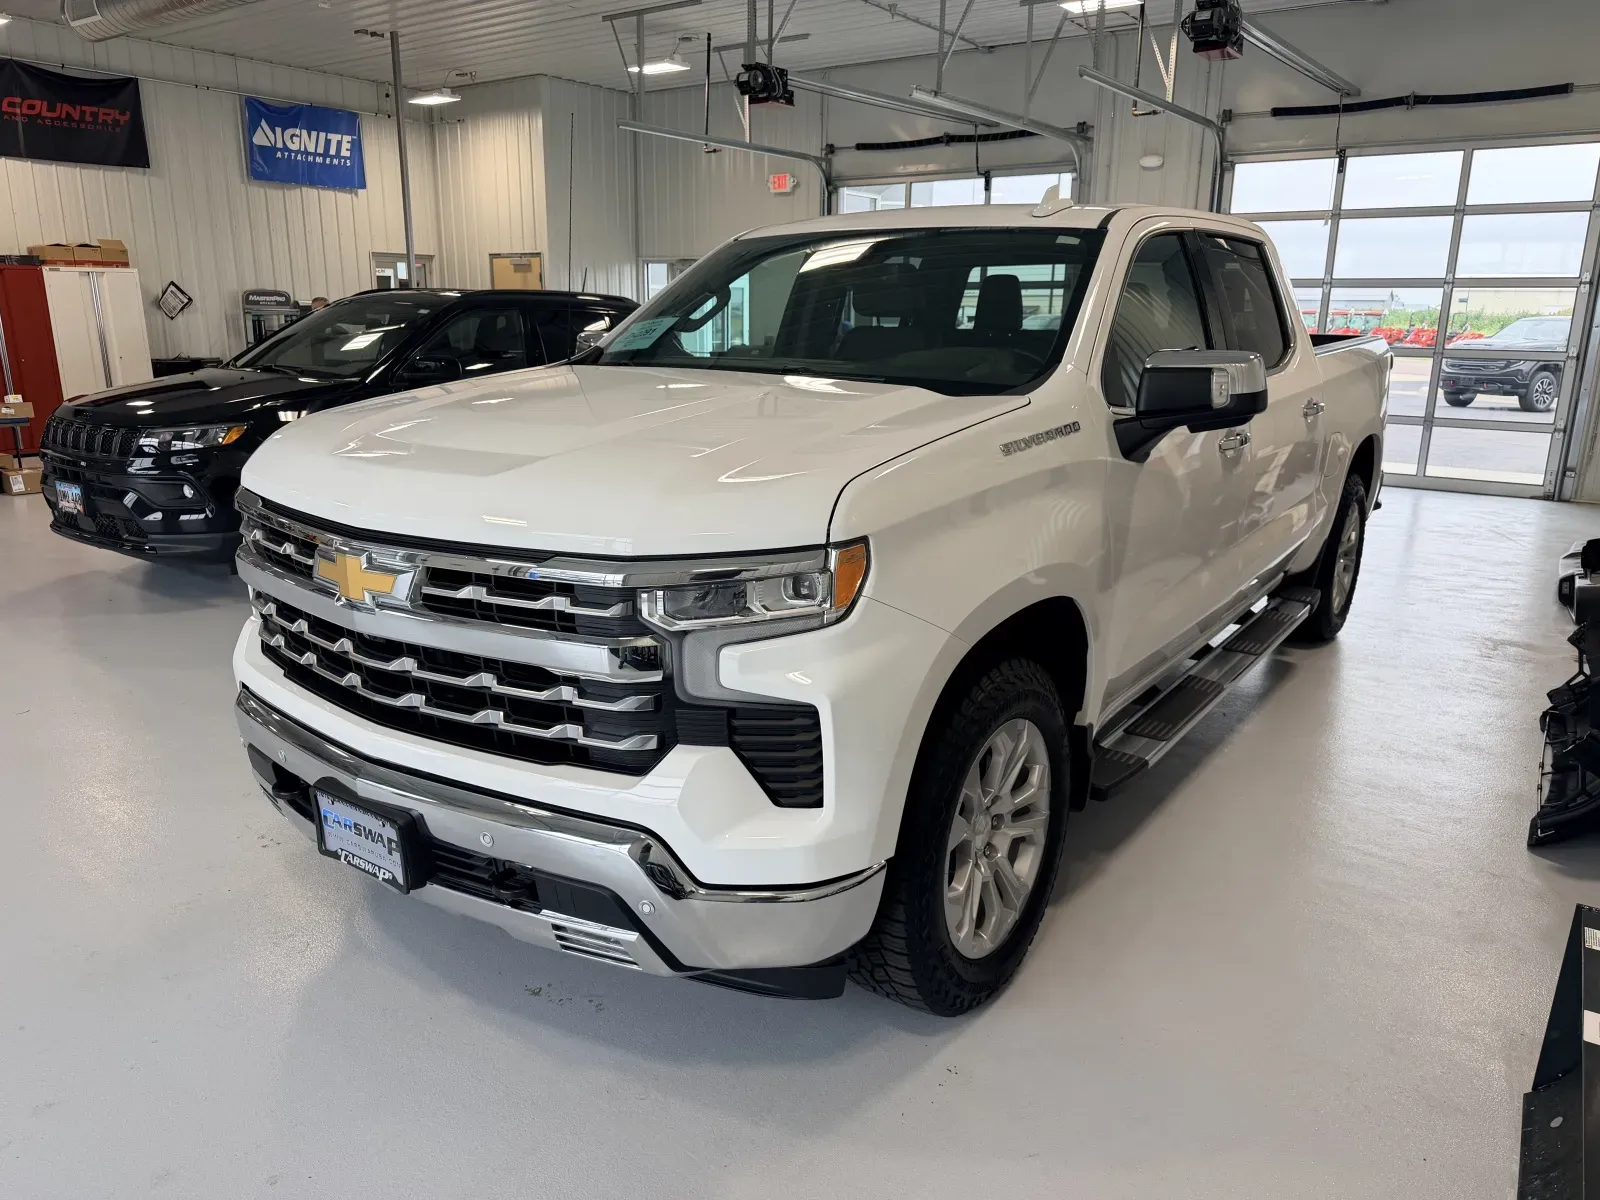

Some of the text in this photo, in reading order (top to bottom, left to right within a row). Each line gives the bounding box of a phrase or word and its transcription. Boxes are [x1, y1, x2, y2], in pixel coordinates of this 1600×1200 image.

[1, 96, 130, 125] COUNTRY
[3, 114, 121, 133] AND ACCESSORIES
[275, 126, 352, 157] IGNITE
[275, 151, 352, 167] ATTACHMENTS
[772, 175, 786, 189] EXIT
[999, 421, 1081, 456] SILVERADO
[322, 809, 400, 856] CARSWAP
[340, 850, 390, 881] CARSWAP
